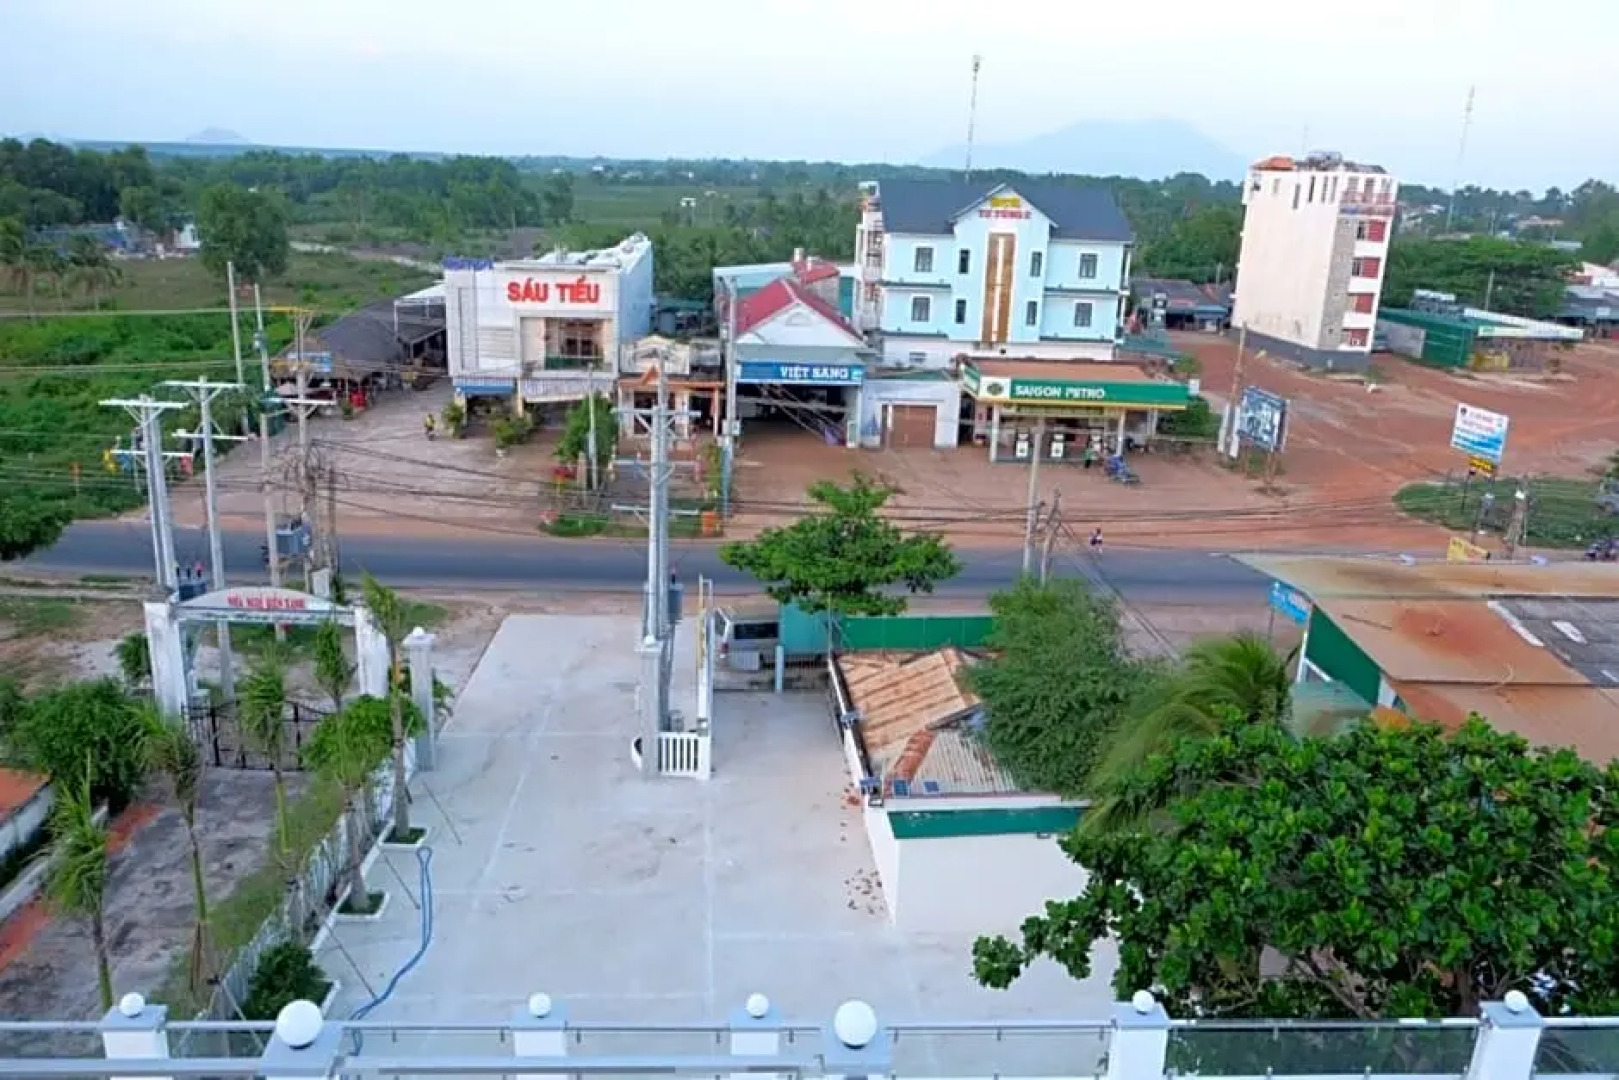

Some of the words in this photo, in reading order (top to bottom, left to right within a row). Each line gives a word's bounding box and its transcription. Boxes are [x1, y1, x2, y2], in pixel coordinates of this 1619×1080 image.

[507, 277, 549, 302] SÁU
[1015, 385, 1062, 398] SAIGON
[1065, 387, 1105, 399] PETRO
